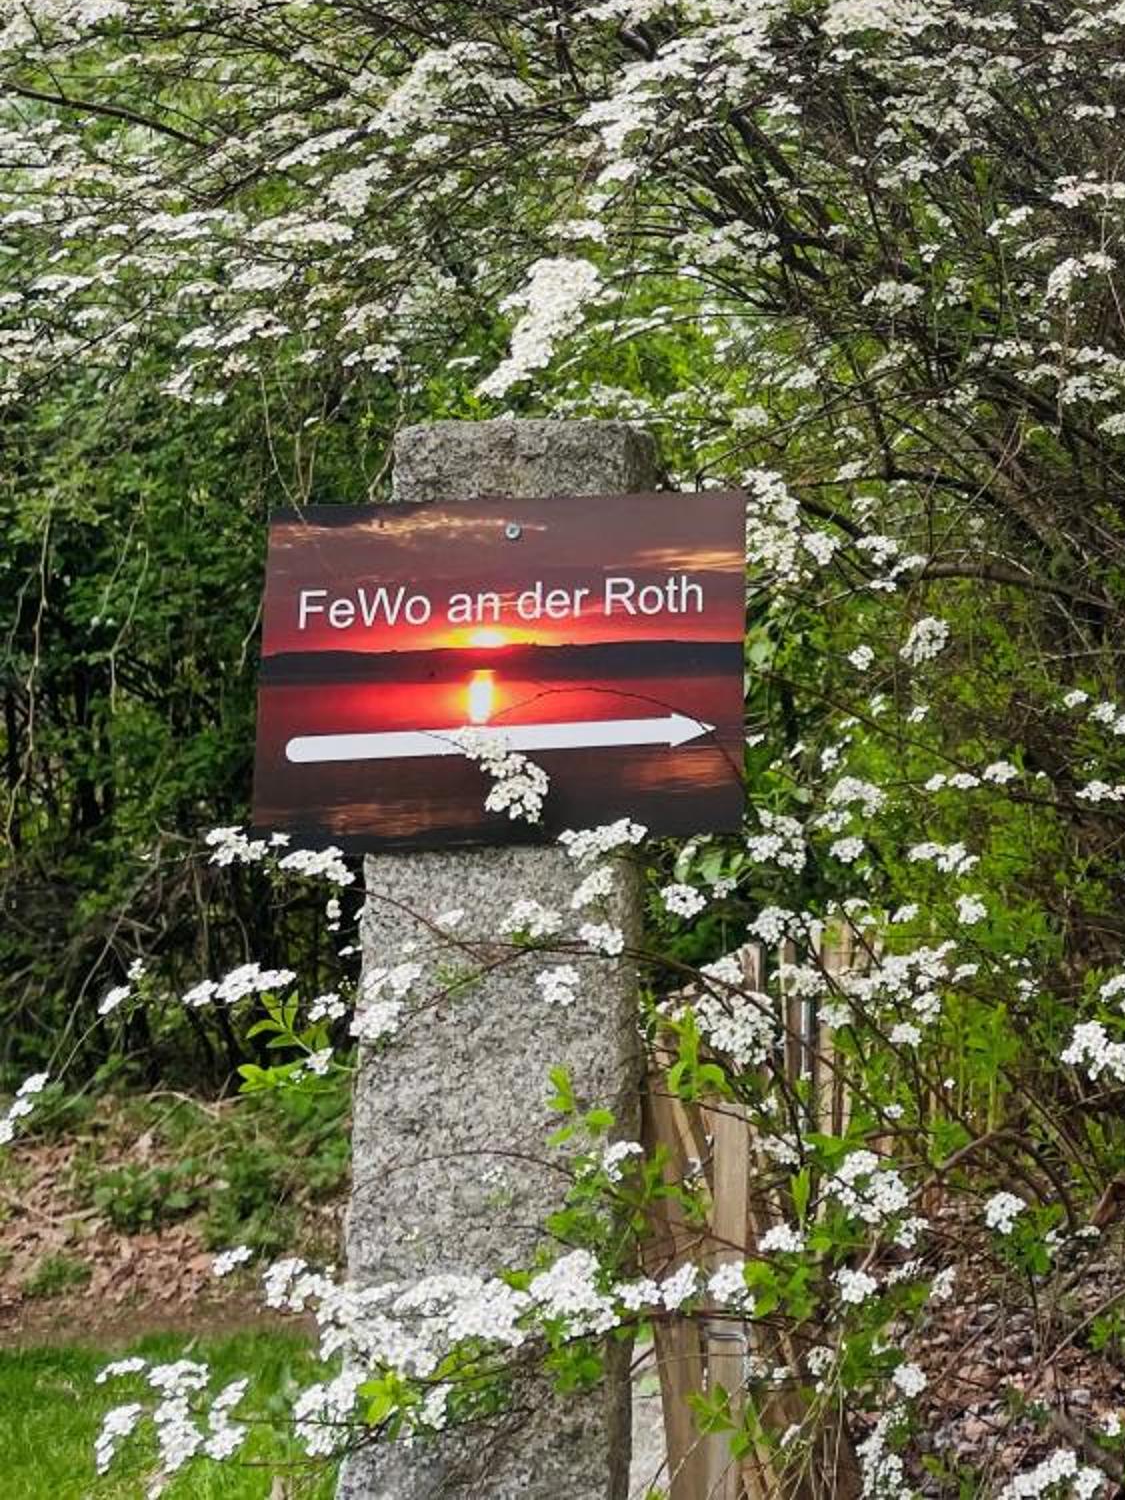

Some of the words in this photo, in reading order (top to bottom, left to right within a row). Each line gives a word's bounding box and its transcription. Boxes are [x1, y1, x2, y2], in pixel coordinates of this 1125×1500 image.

[299, 587, 432, 629] FeWo
[447, 593, 499, 622] an
[516, 581, 590, 620] der
[603, 576, 704, 616] Roth
